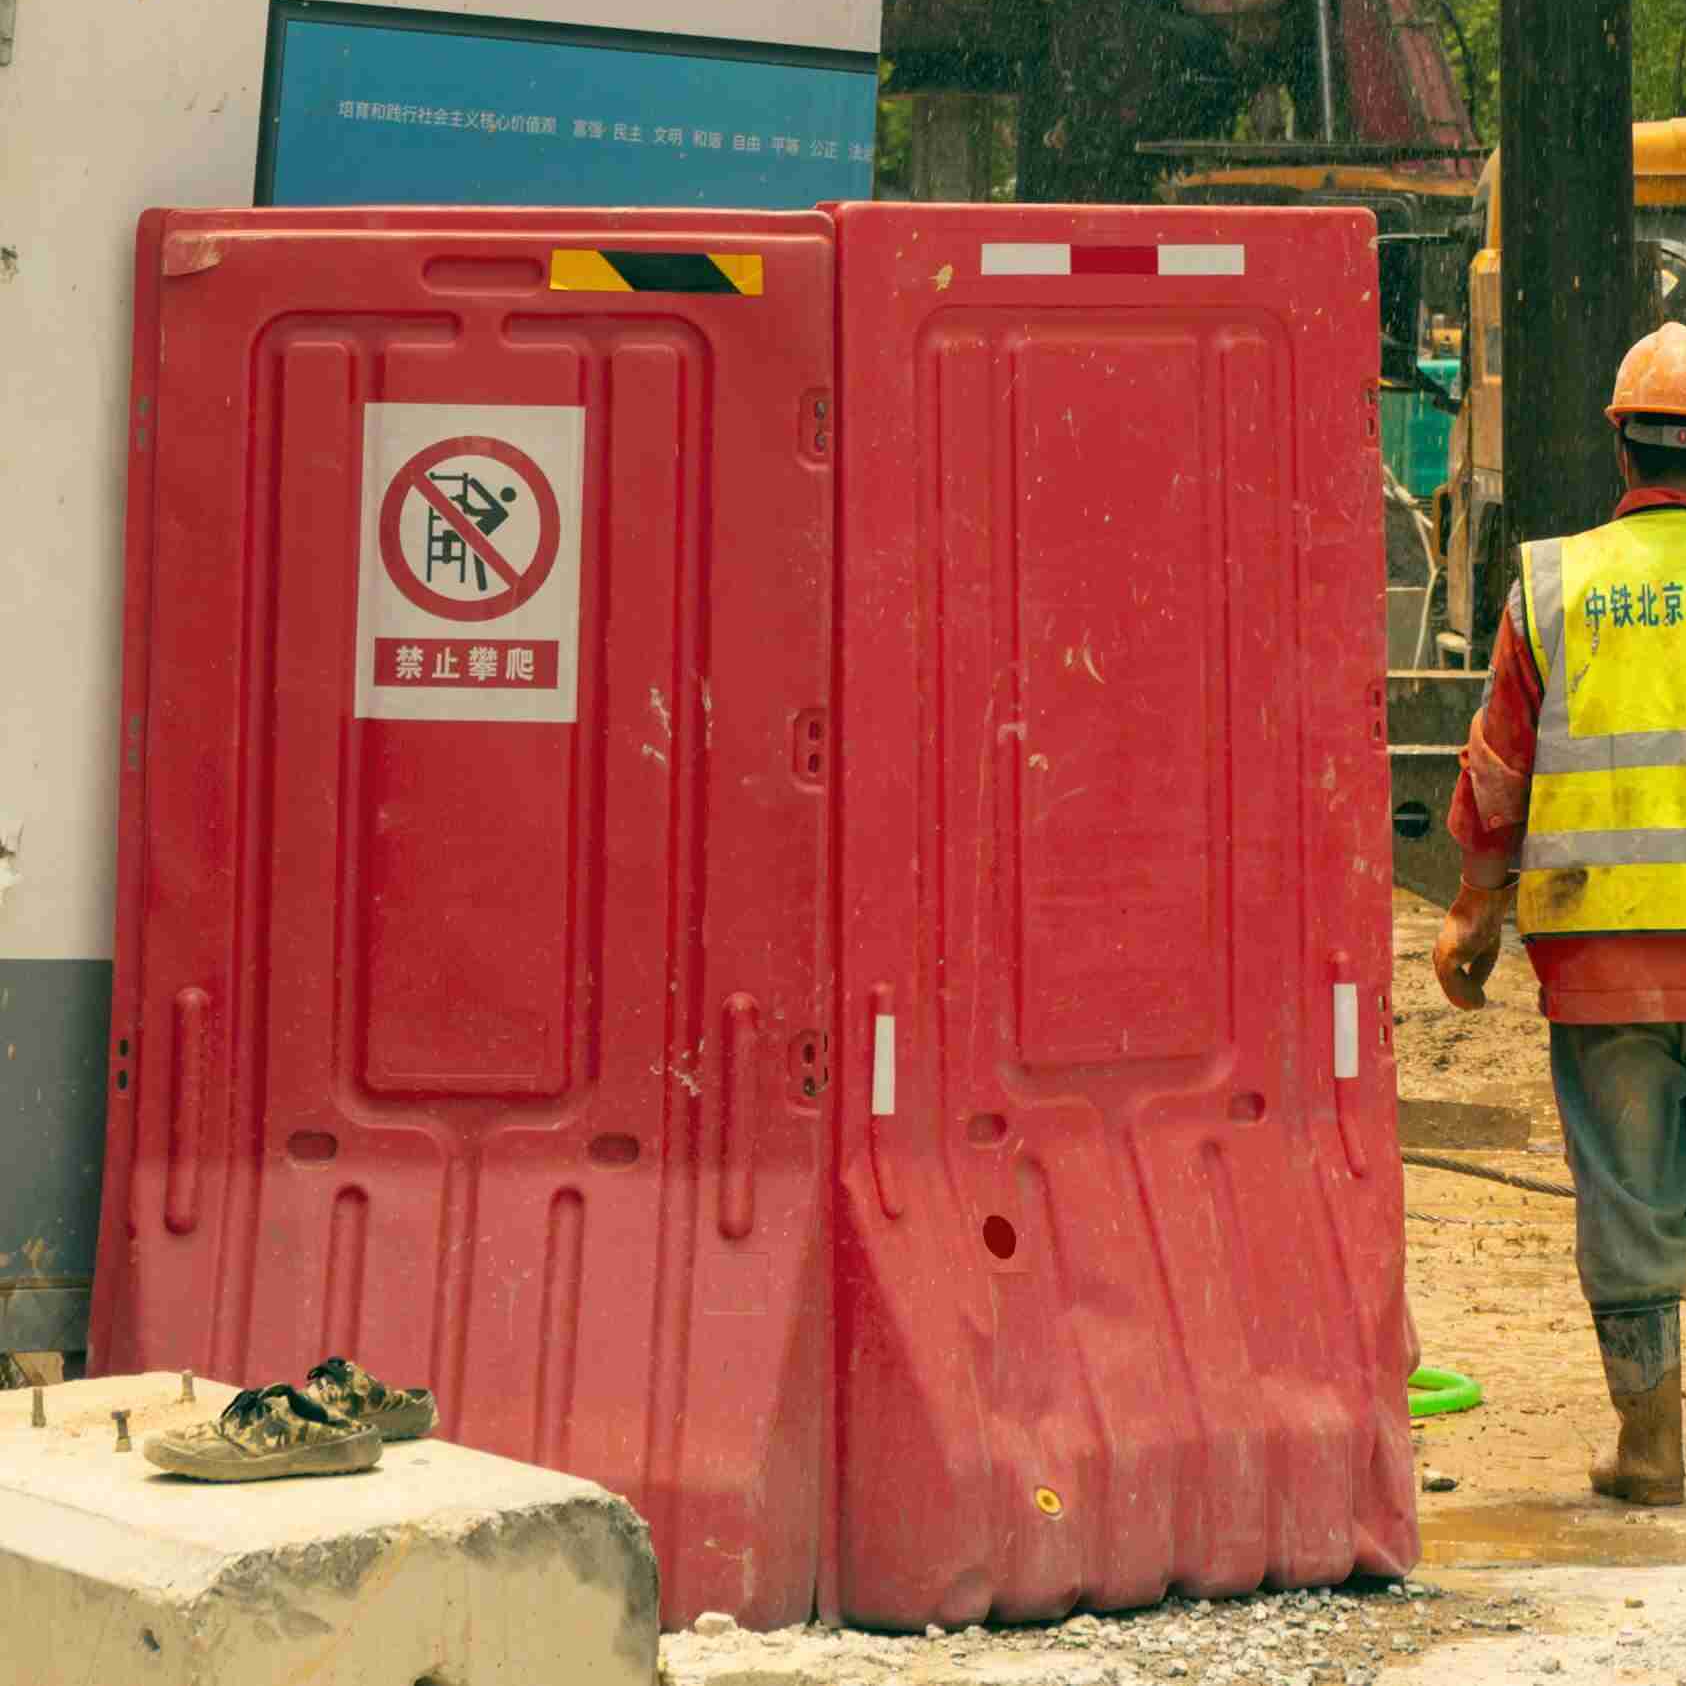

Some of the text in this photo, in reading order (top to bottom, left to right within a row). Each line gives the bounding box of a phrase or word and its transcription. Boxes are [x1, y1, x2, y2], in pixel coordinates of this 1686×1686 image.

[338, 99, 556, 134] 培育和践行社会主义核心价值观
[613, 123, 641, 142] 民主
[655, 126, 683, 147] 文明
[734, 133, 761, 152] 自由
[809, 139, 840, 161] 公正
[396, 645, 535, 682] 禁止攀爬
